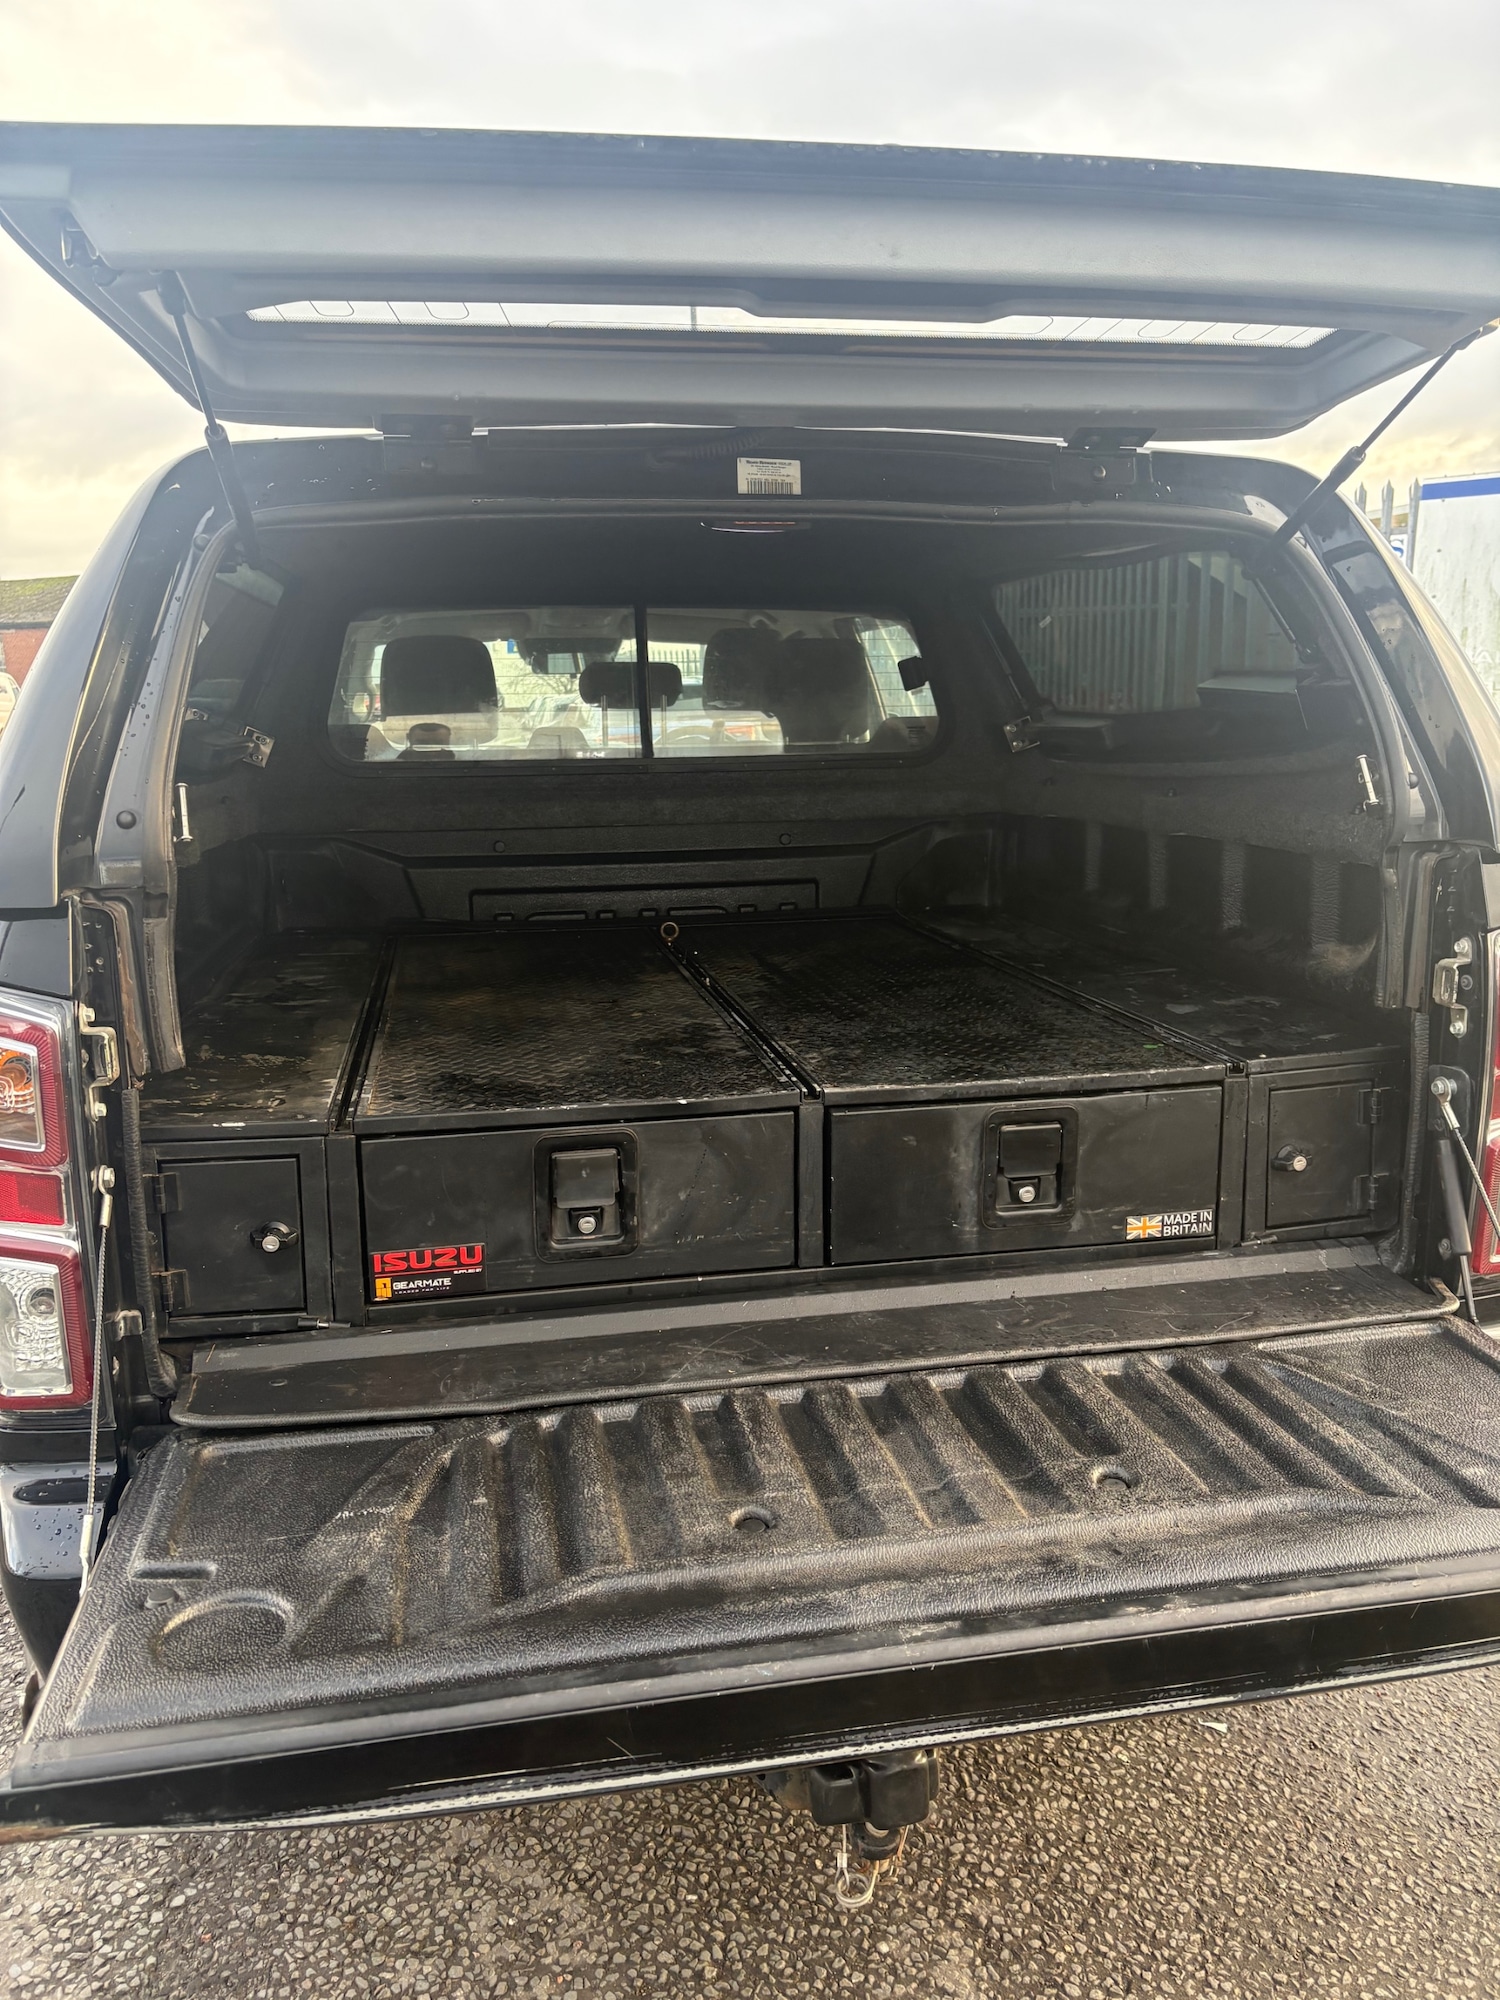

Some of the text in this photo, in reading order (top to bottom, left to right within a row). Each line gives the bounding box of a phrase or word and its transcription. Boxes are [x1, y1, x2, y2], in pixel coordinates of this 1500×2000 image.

[1164, 1210, 1212, 1225] MADE IN
[1164, 1222, 1212, 1236] BRITAIN
[373, 1245, 482, 1273] ISUZU
[393, 1278, 452, 1290] GEARMATE
